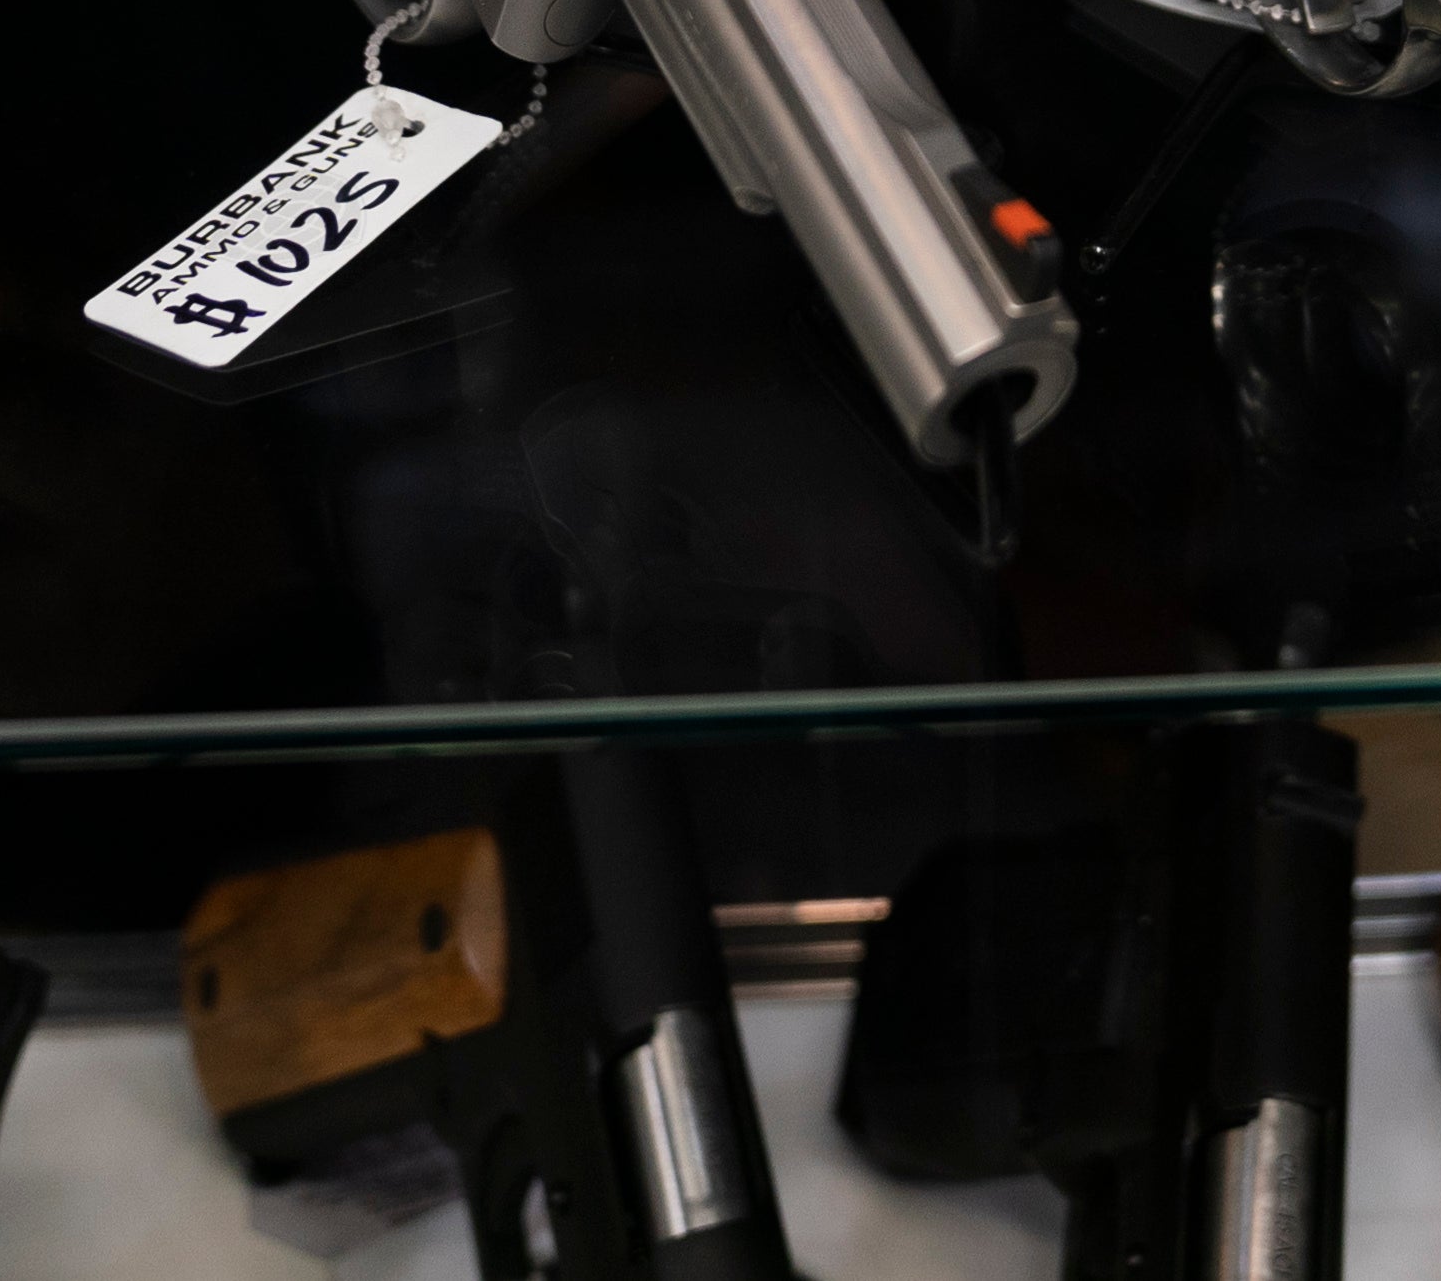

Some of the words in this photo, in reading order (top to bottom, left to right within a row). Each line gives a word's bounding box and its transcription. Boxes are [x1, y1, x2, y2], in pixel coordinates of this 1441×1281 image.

[116, 113, 362, 298] BURBANK
[152, 219, 260, 305] AMMO
[262, 198, 291, 215] &
[290, 122, 378, 191] GUNS
